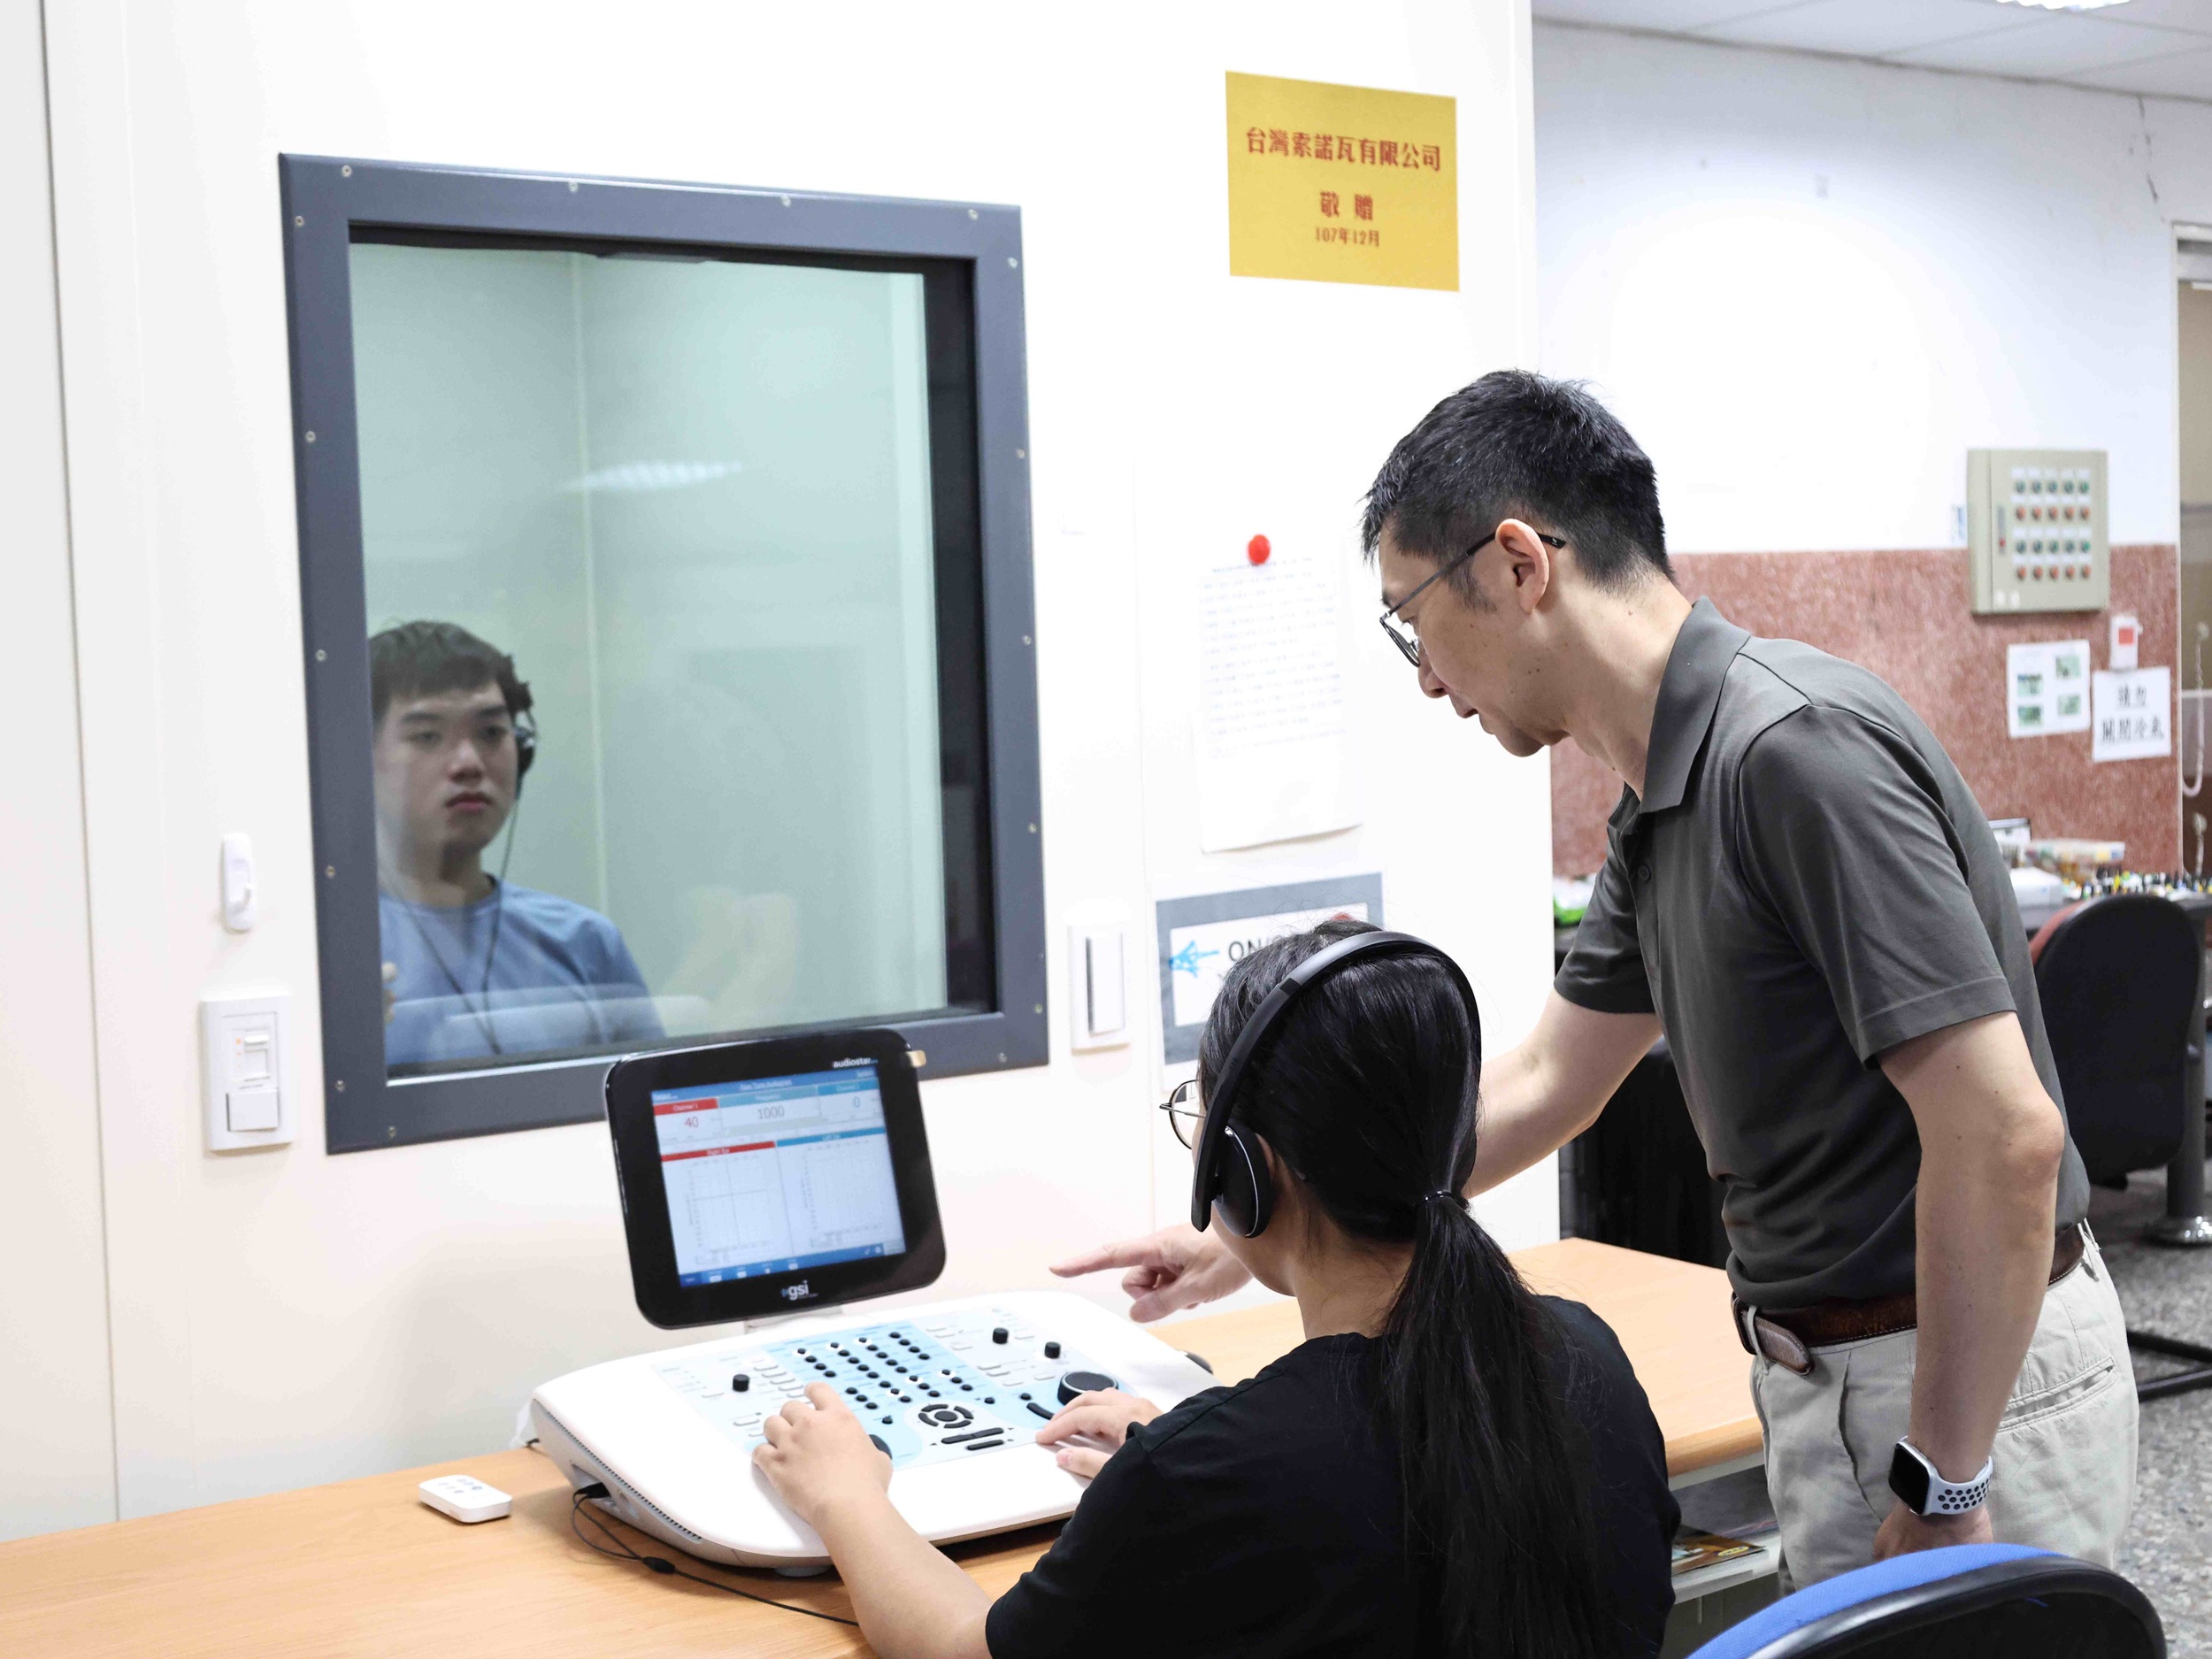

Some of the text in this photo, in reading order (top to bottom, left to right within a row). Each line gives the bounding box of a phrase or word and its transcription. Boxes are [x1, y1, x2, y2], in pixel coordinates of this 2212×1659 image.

[1247, 127, 1440, 171] 台灣索諾瓦有限公司
[1315, 227, 1379, 247] 107年12月
[853, 1096, 861, 1109] 0
[757, 1105, 785, 1119] 1000
[684, 1116, 699, 1129] 40
[787, 1279, 810, 1301] gsi
